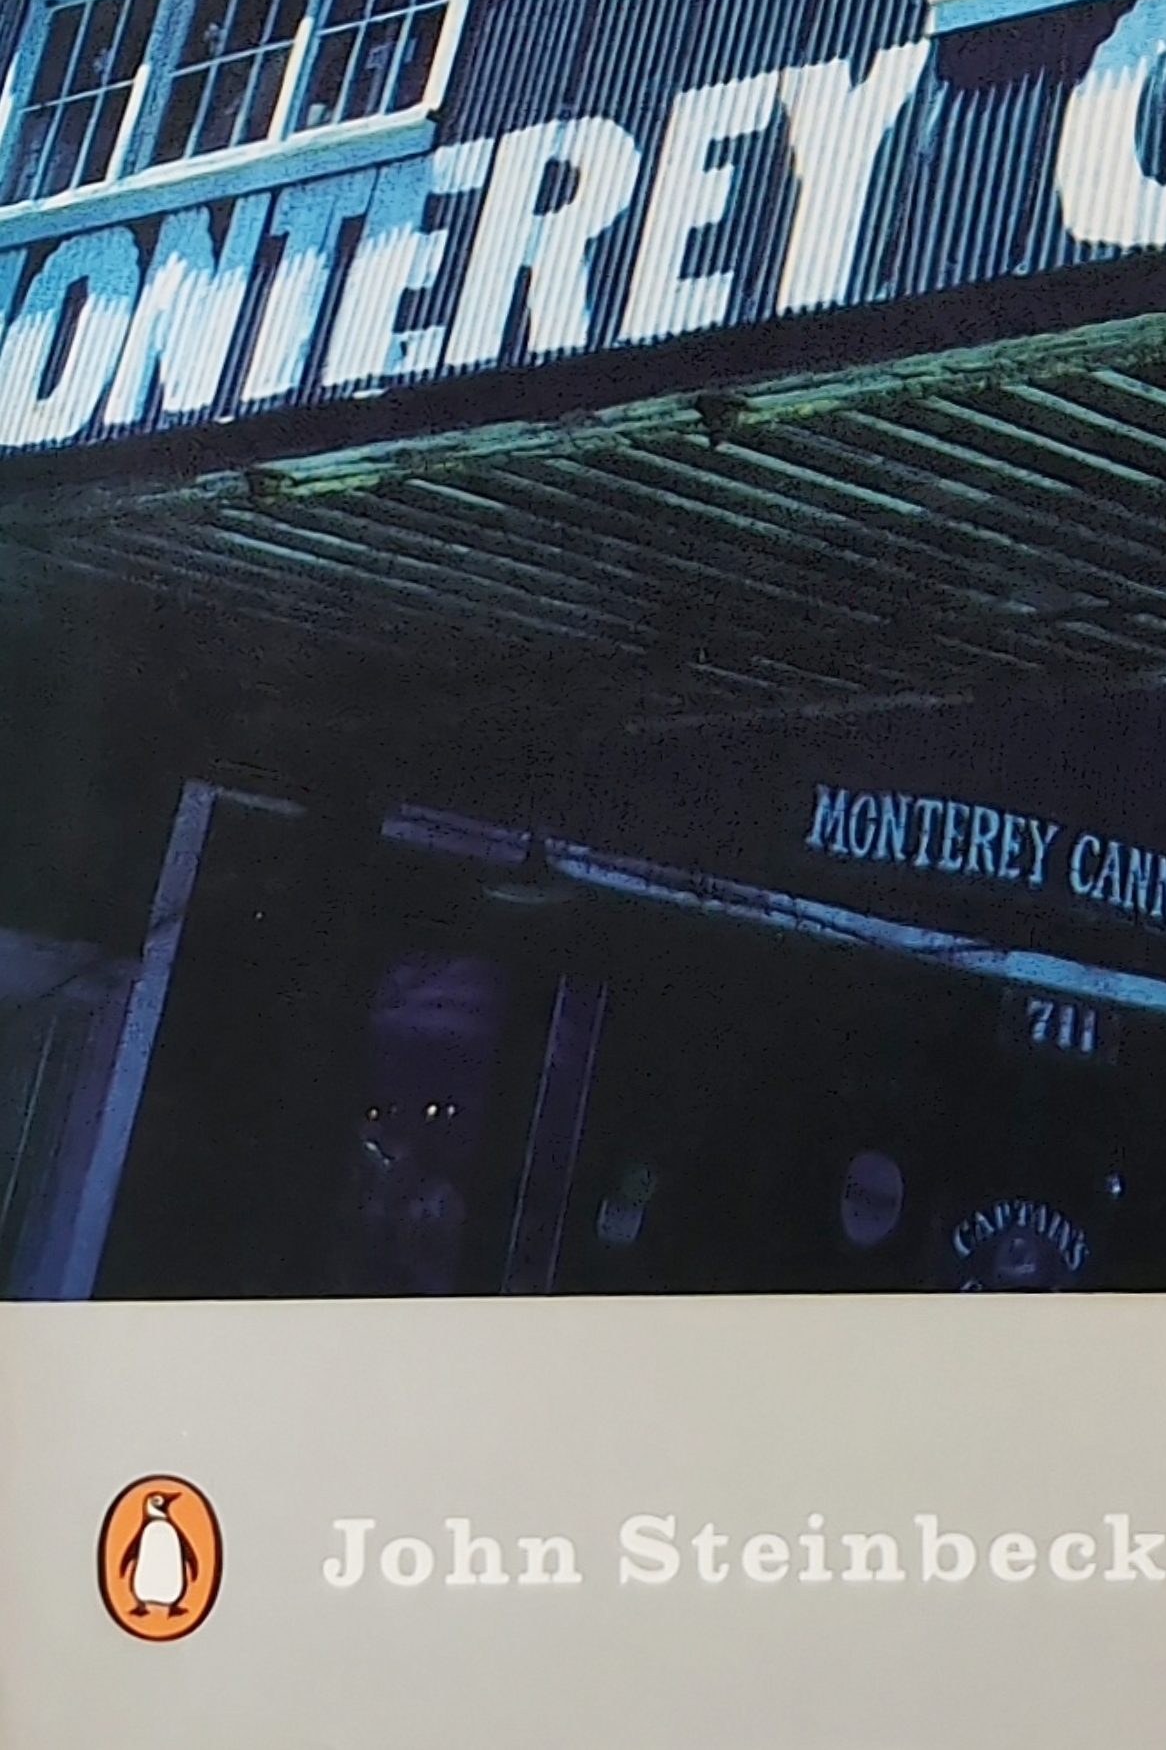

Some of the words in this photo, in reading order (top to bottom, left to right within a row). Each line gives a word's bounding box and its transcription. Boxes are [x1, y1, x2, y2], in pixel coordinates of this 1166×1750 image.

[0, 38, 931, 446] ONTEREY
[806, 784, 1059, 887] MONTEREY
[1026, 999, 1098, 1054] 711
[321, 1517, 584, 1588] John
